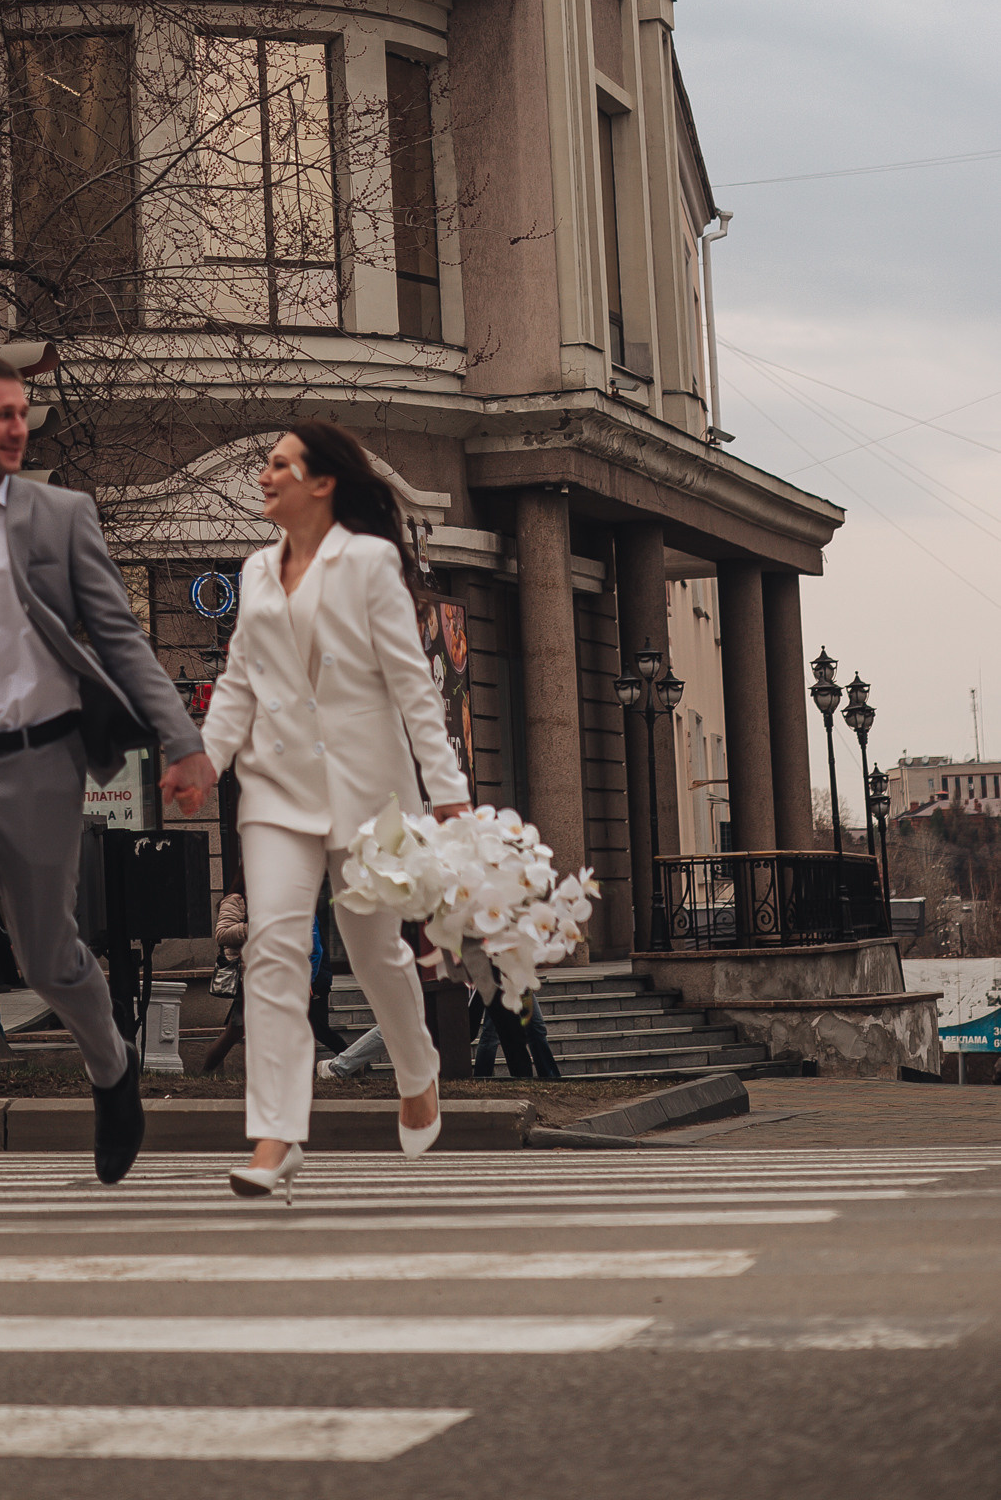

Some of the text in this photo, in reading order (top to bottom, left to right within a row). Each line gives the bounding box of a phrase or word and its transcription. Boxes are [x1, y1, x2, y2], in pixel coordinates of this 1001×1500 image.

[84, 790, 132, 802] ПЛАТНО
[91, 807, 133, 820] АЙ
[945, 1035, 988, 1044] РЕКЛАМА
